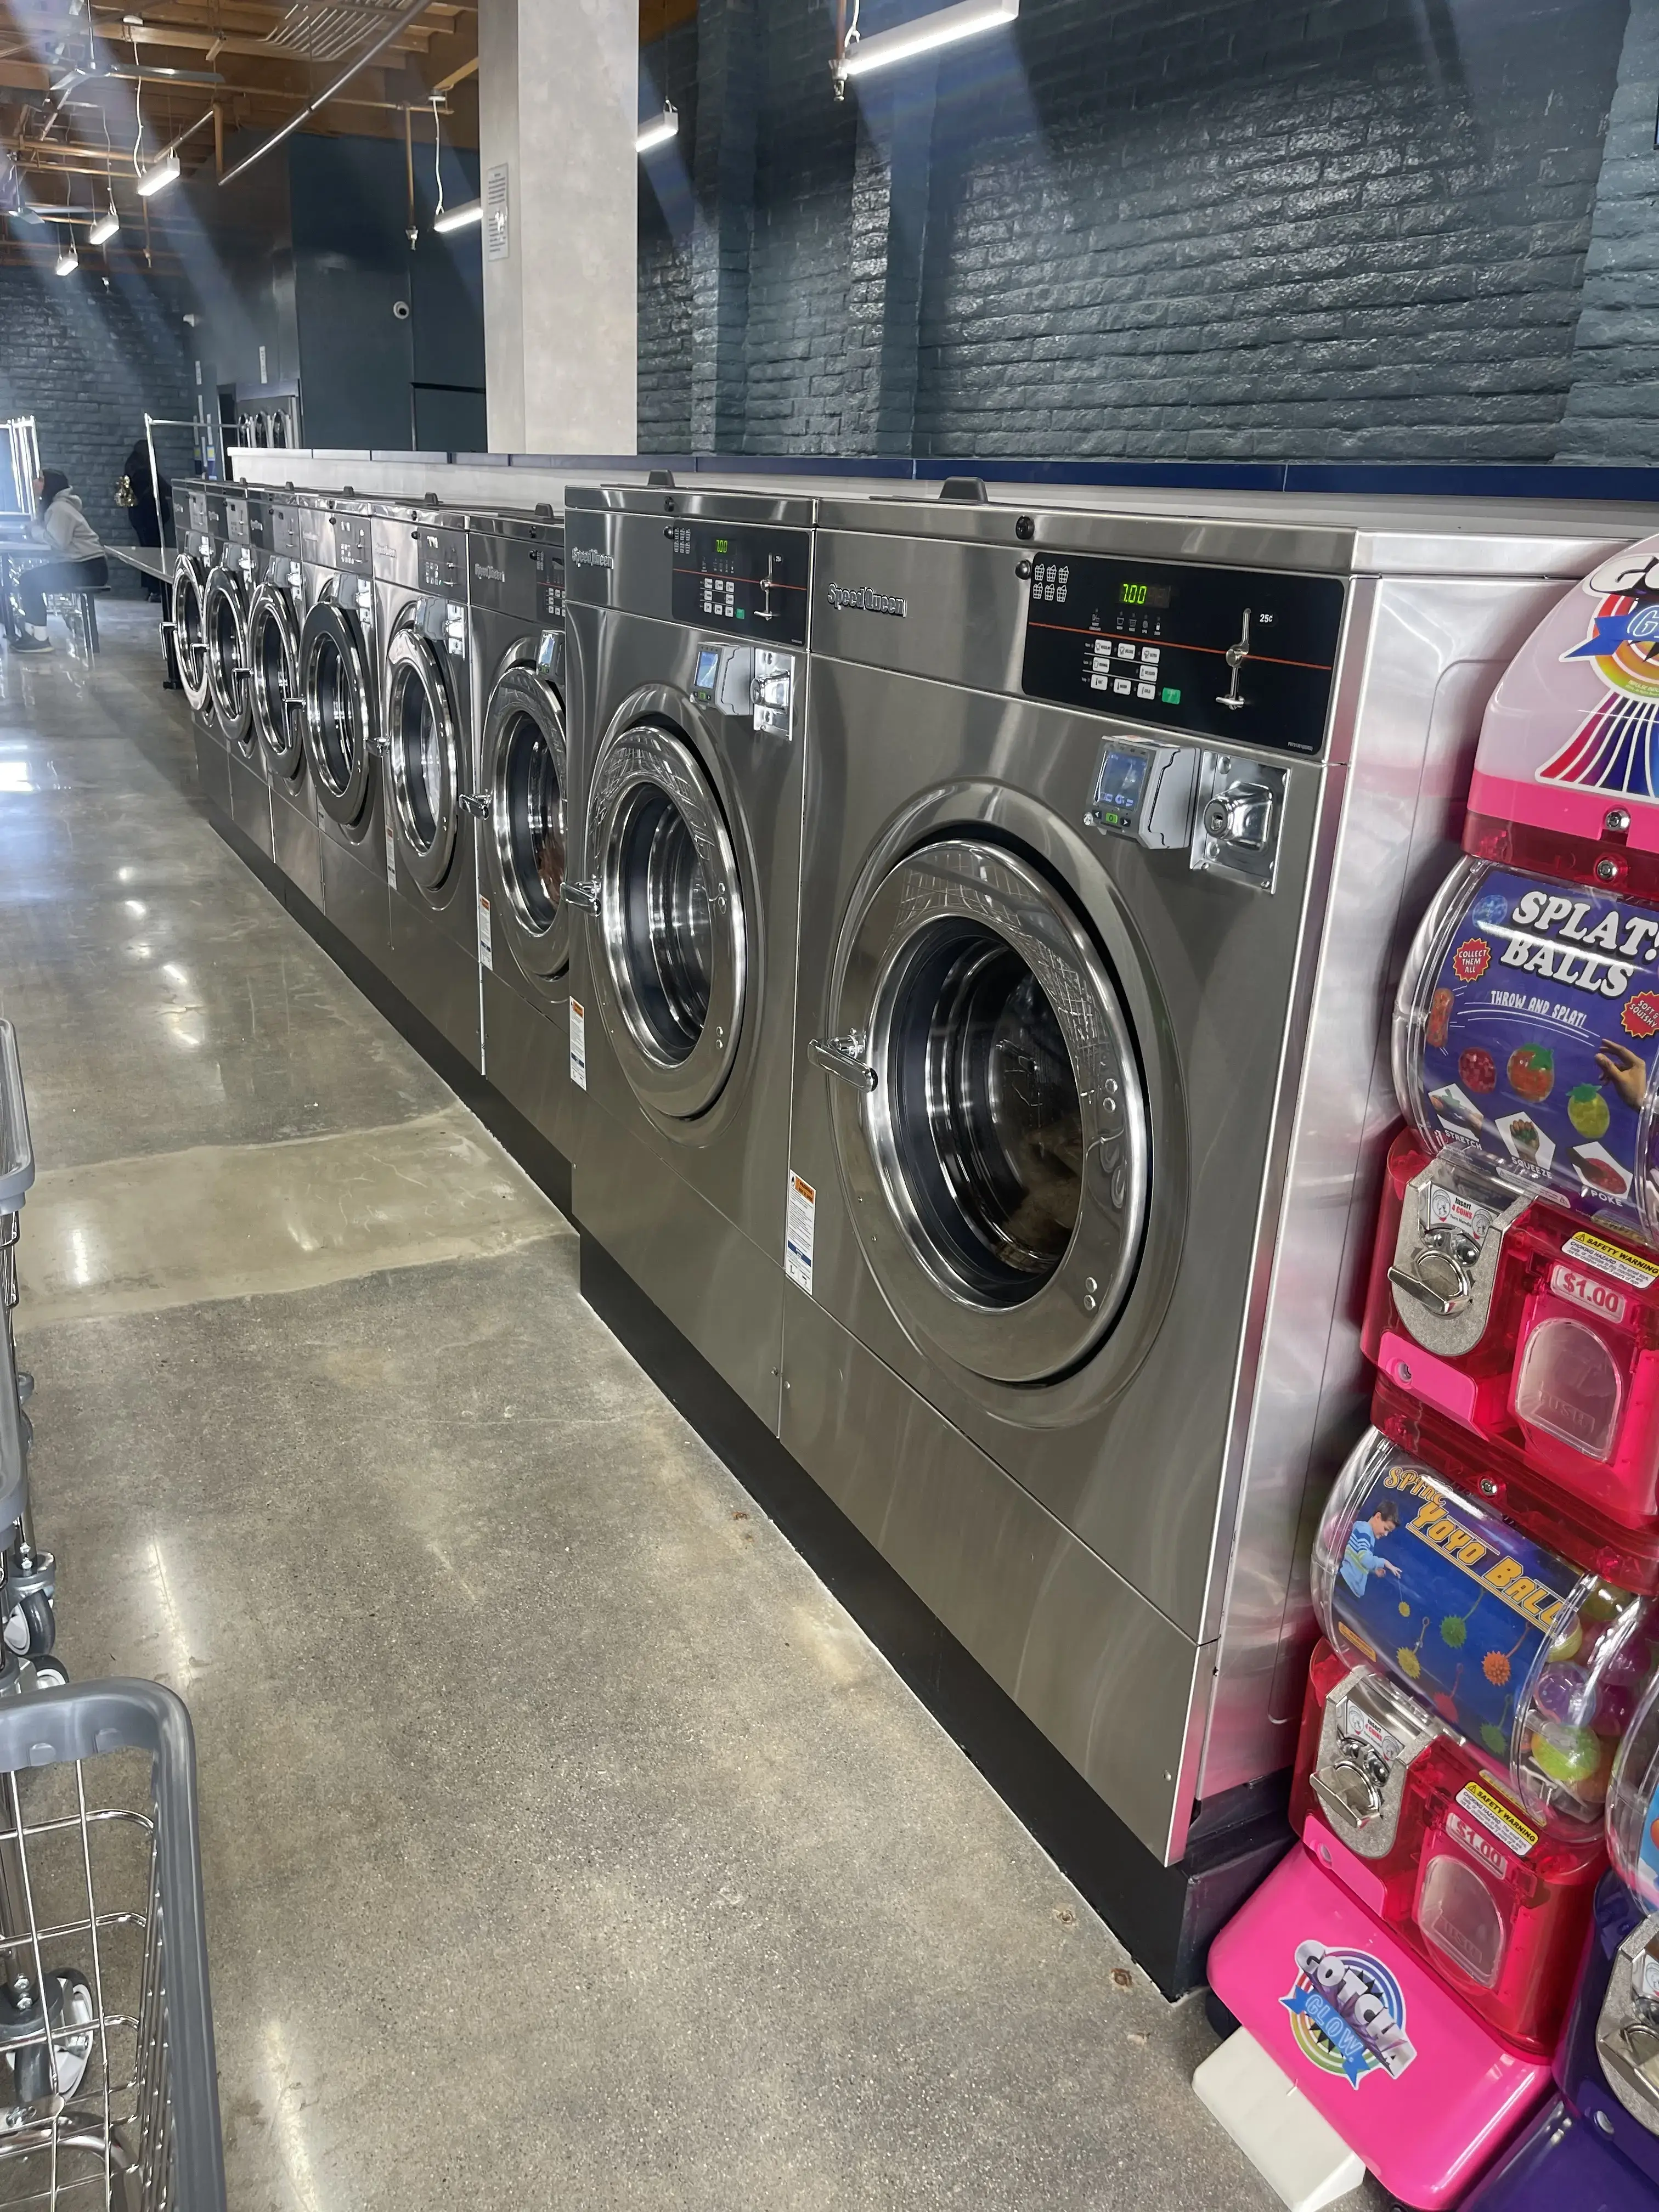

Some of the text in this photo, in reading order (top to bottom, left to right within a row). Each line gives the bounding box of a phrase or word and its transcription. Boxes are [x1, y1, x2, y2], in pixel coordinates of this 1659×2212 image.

[827, 582, 907, 618] Speed Queen
[1123, 583, 1147, 604] 7.00
[1259, 613, 1273, 623] 25¢
[1459, 950, 1487, 958] COLLECT
[1500, 936, 1634, 997] BALLS
[1491, 990, 1588, 1028] THROW AND SPLAT!
[1629, 1003, 1657, 1028] SQUISHY
[1638, 1000, 1655, 1015] SOFT
[1444, 1130, 1482, 1150] STRETCH
[1511, 1156, 1553, 1179] SQUEEZE
[1455, 1197, 1471, 1210] Insert
[1590, 1190, 1623, 1207] POKE
[1456, 1206, 1473, 1220] COINS
[1570, 1241, 1594, 1255] CHOKING
[1594, 1252, 1616, 1265] HAZARD
[1587, 1238, 1659, 1274] SAFETY WARNING
[1562, 1273, 1619, 1313] $1.00
[1409, 1500, 1566, 1629] YOYO BALL
[1477, 1791, 1504, 1814] SAFETY
[1503, 1812, 1536, 1842] WARNING
[1295, 1940, 1417, 2078] GOTCHA
